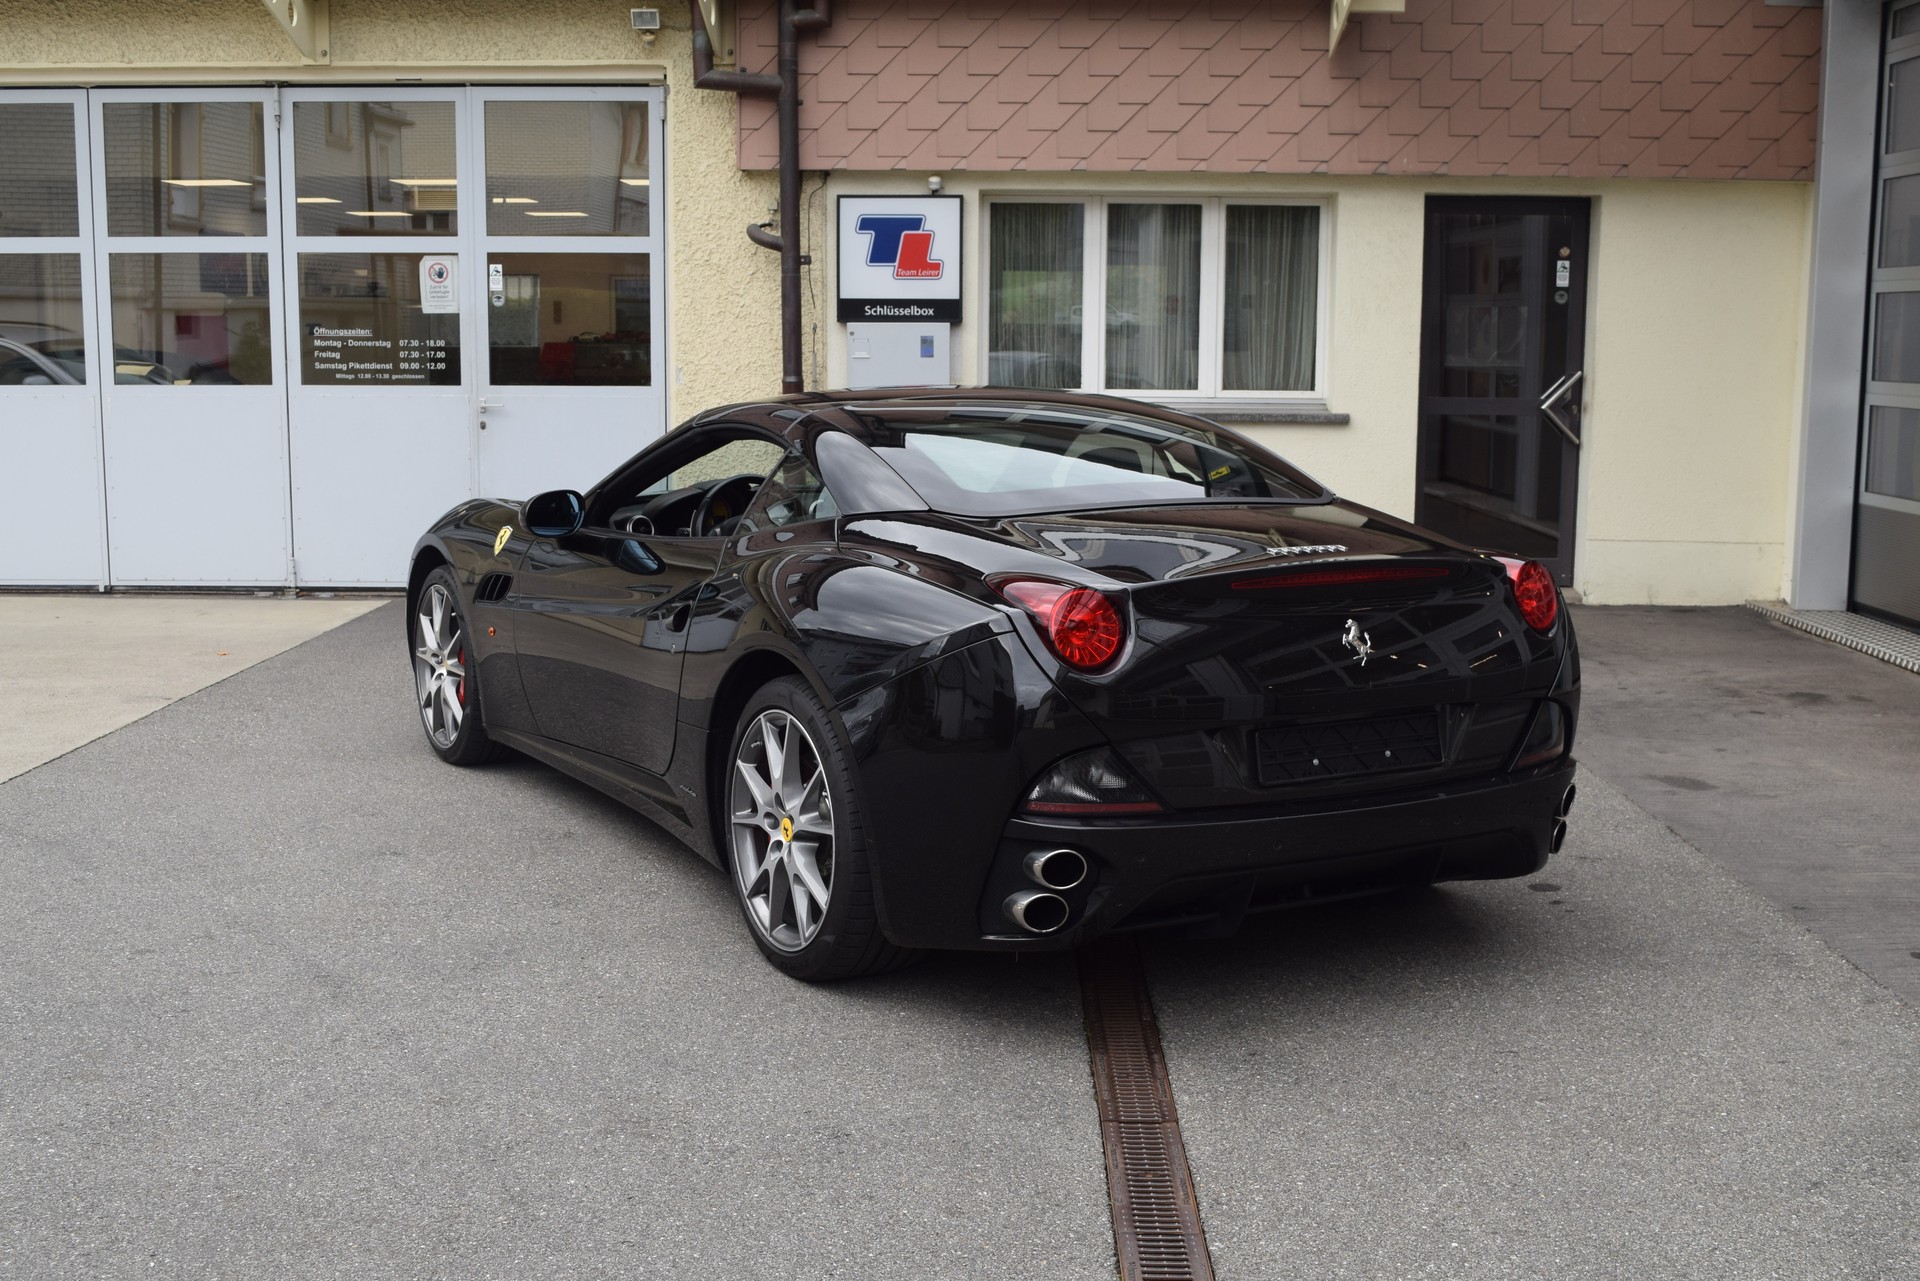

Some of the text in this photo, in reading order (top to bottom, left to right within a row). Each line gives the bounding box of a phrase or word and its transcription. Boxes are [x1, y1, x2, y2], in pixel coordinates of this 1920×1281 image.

[897, 268, 939, 276] Team Leirer
[864, 305, 934, 316] Schlüsselbox
[313, 327, 373, 336] Öffnungszeiten:
[314, 339, 342, 348] Montag
[348, 339, 391, 348] Donnerstag
[399, 339, 419, 347] 07.30
[426, 339, 445, 347] 18.00
[314, 351, 340, 359] Freitag
[314, 362, 347, 370] Samstag
[400, 362, 420, 370] 09.00
[426, 362, 446, 370] 12.00
